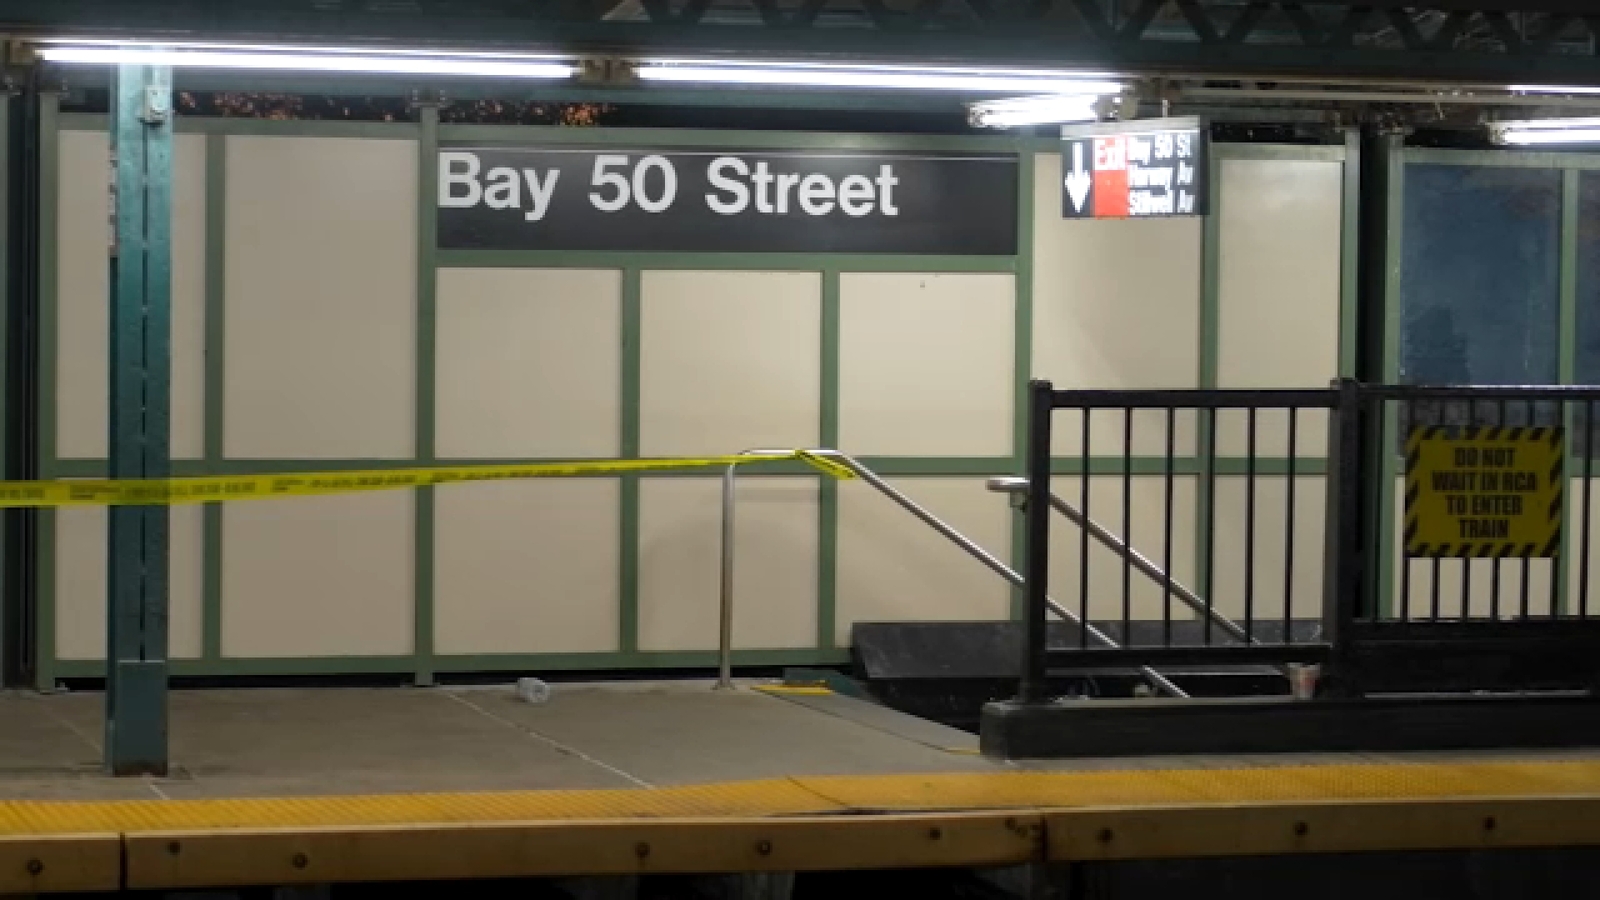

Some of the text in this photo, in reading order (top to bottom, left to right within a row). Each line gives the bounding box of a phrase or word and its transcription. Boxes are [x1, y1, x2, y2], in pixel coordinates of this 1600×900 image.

[437, 152, 899, 221] Bay 50 Street
[1454, 447, 1516, 468] DO NOT
[1432, 471, 1476, 491] WAIT
[1480, 472, 1499, 491] IN
[1446, 495, 1523, 515] TO ENTER
[1459, 519, 1509, 539] TRAIN
